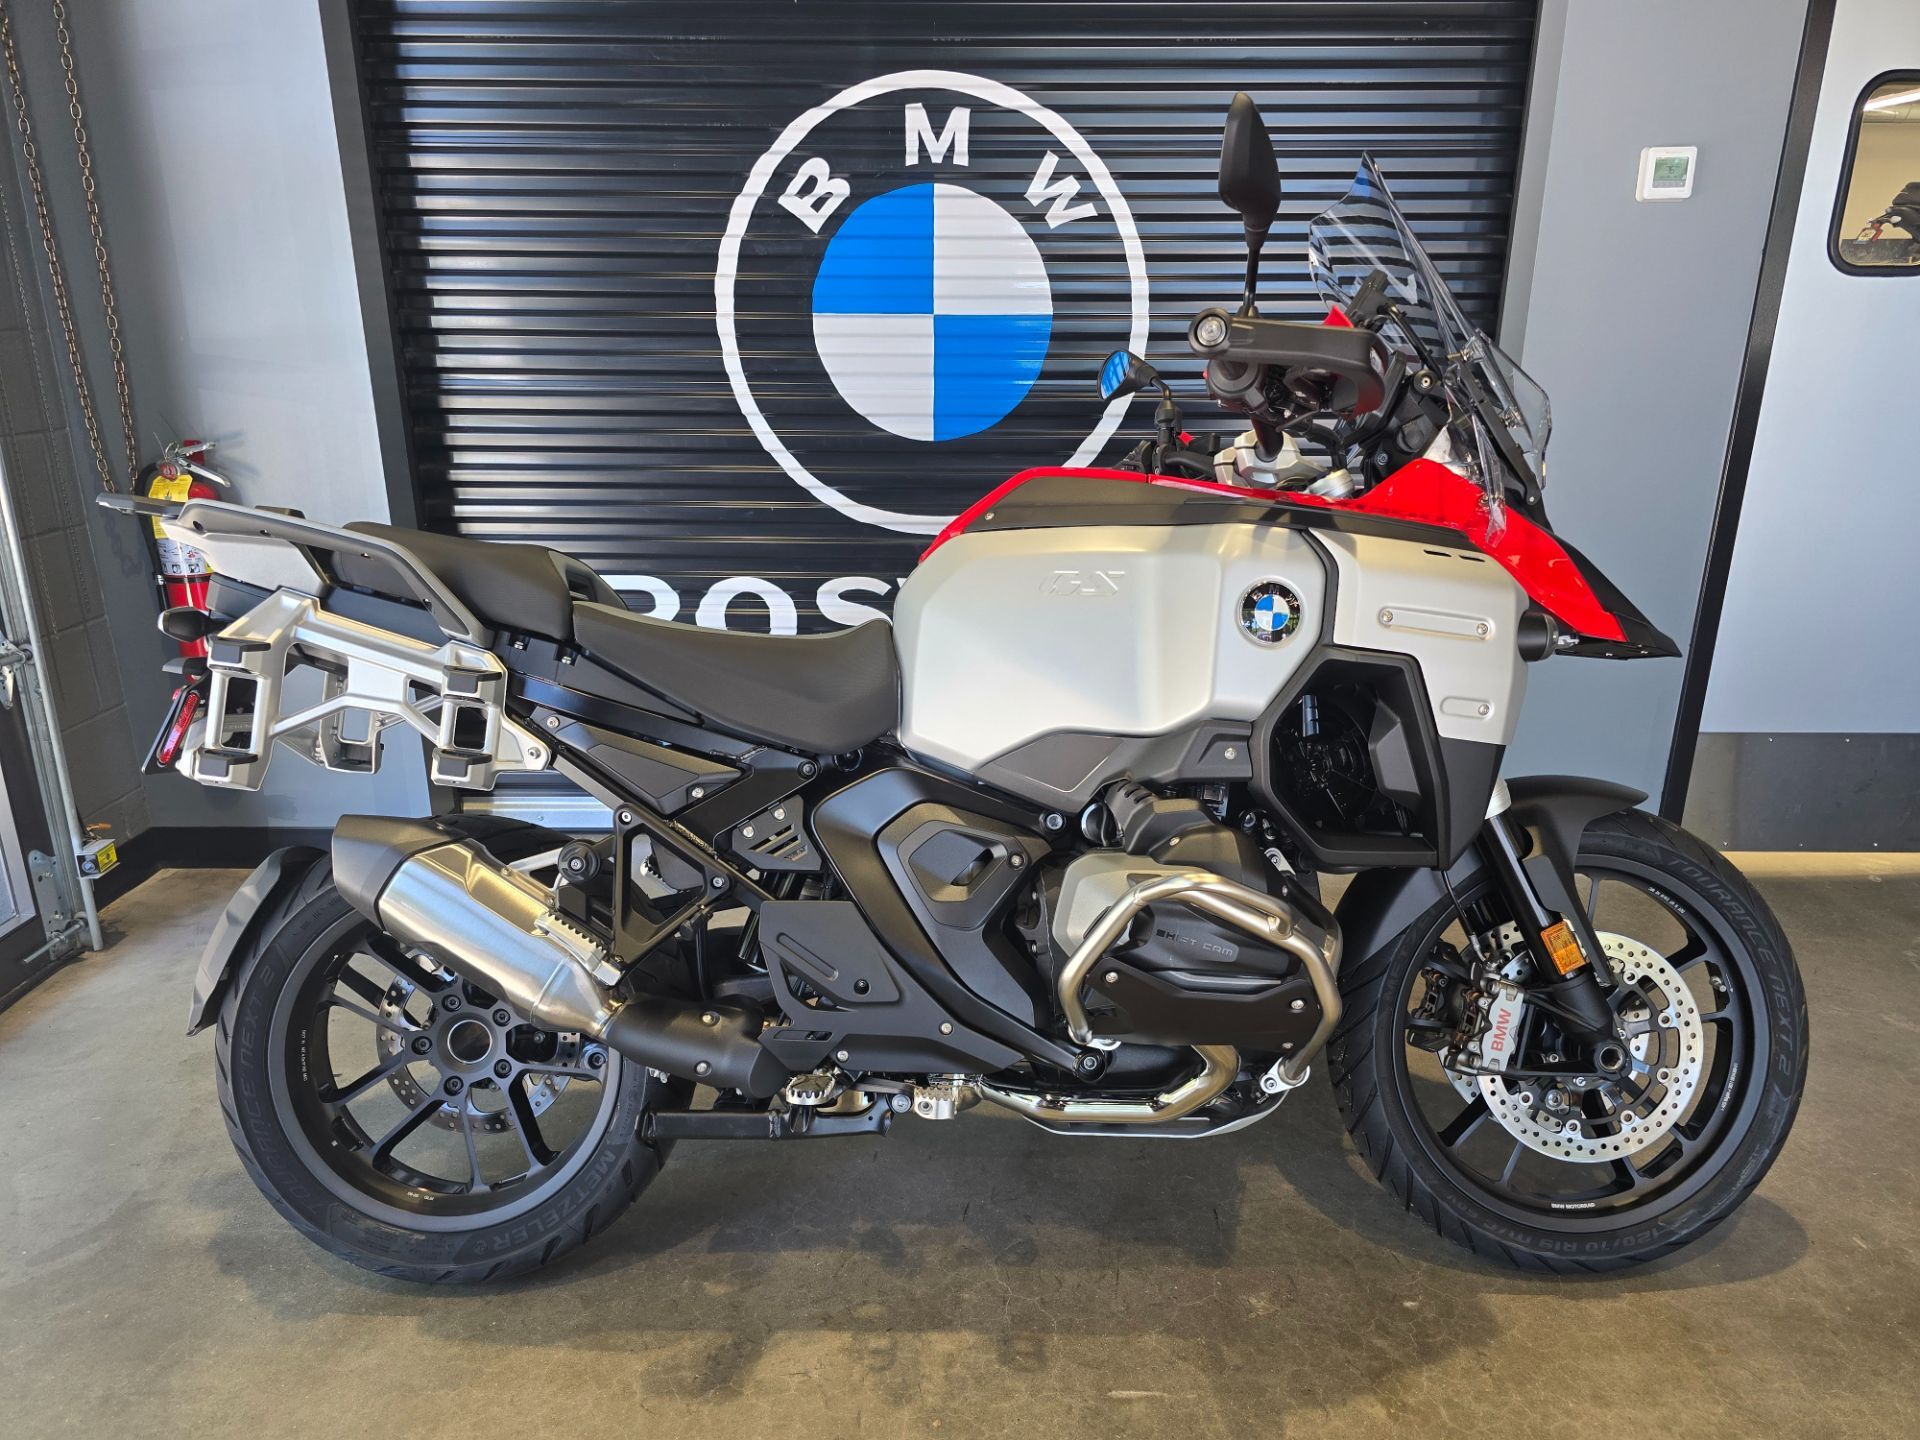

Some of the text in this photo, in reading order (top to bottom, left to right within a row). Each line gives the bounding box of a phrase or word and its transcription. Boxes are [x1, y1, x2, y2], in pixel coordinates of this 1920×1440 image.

[778, 102, 1098, 234] BMW
[1039, 570, 1126, 597] GS
[1155, 928, 1199, 946] SHIFT
[1490, 1007, 1512, 1052] BMW
[490, 1147, 621, 1251] METZELER
